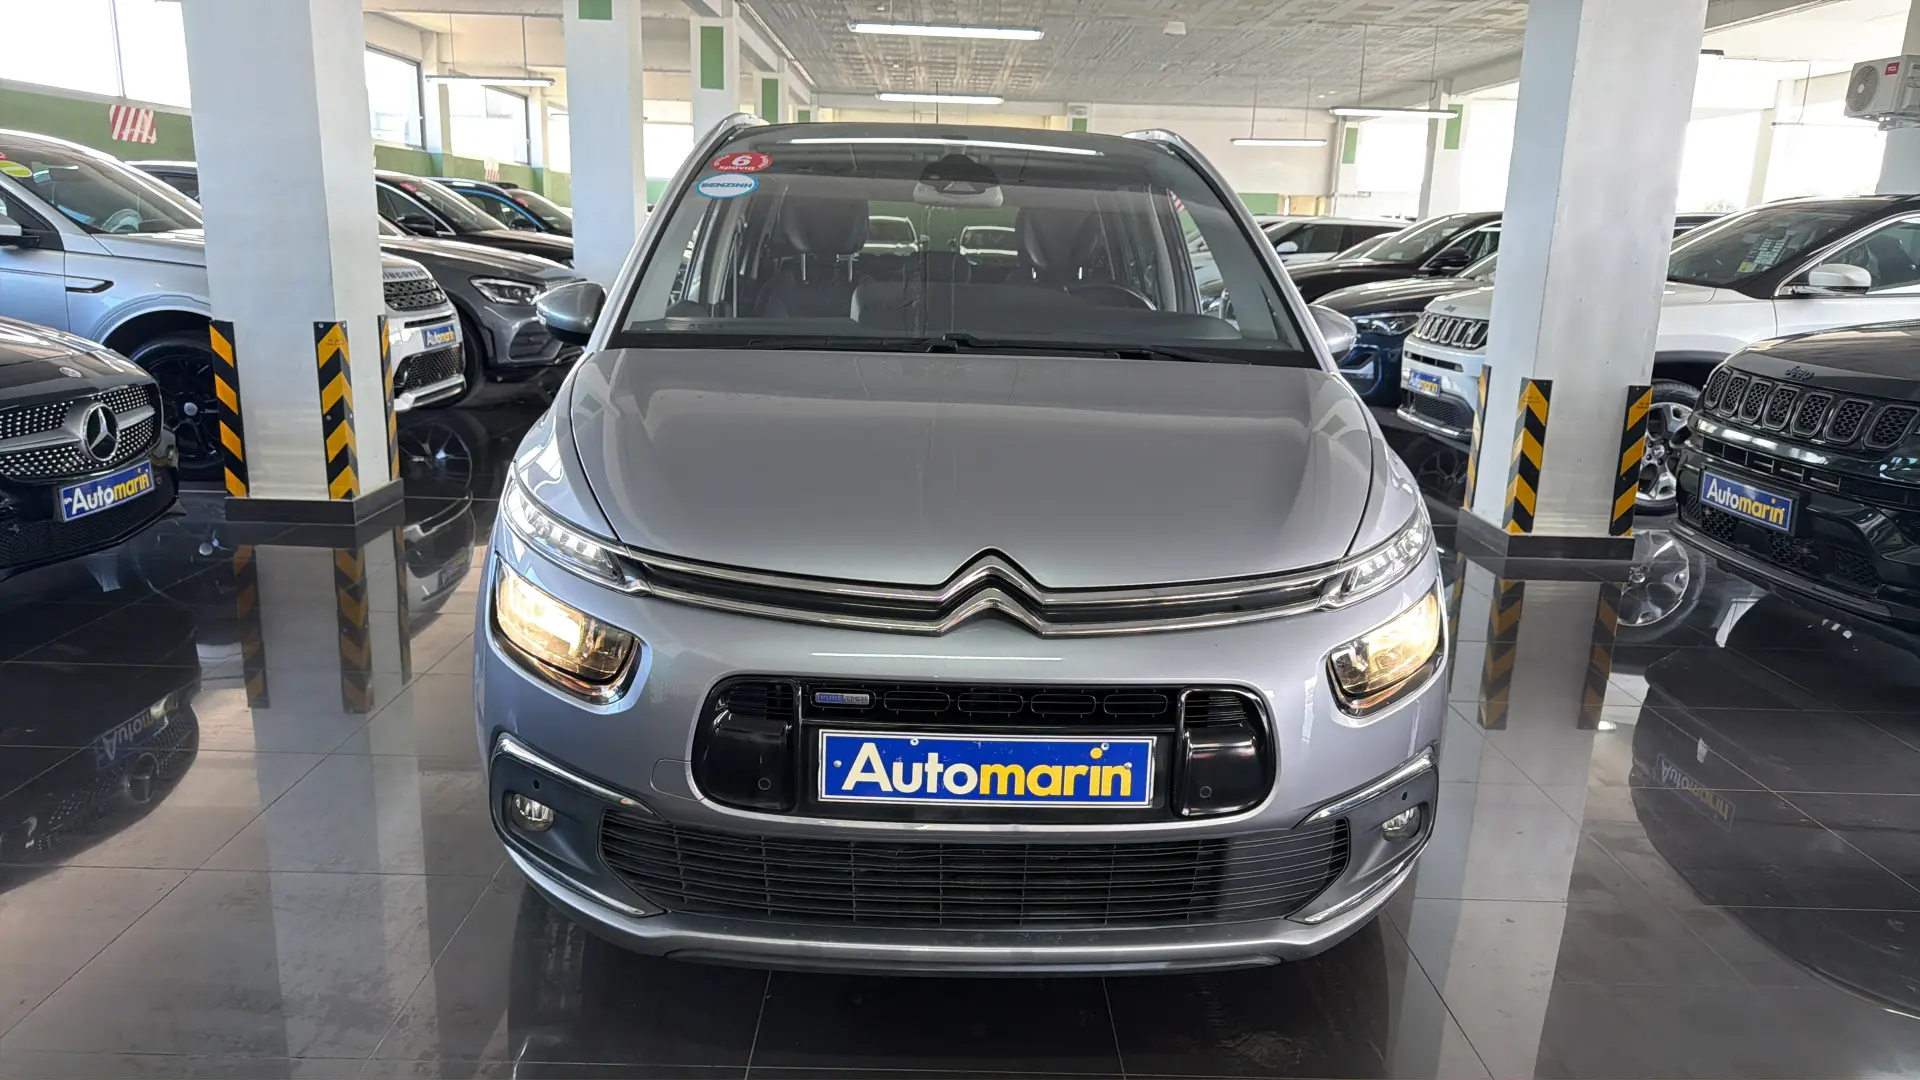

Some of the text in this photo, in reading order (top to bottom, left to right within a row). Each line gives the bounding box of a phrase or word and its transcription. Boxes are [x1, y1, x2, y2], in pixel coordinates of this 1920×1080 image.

[732, 154, 753, 166] 6
[71, 467, 150, 515] Automarin
[1706, 477, 1786, 525] Automarin
[841, 742, 1132, 797] Automarin
